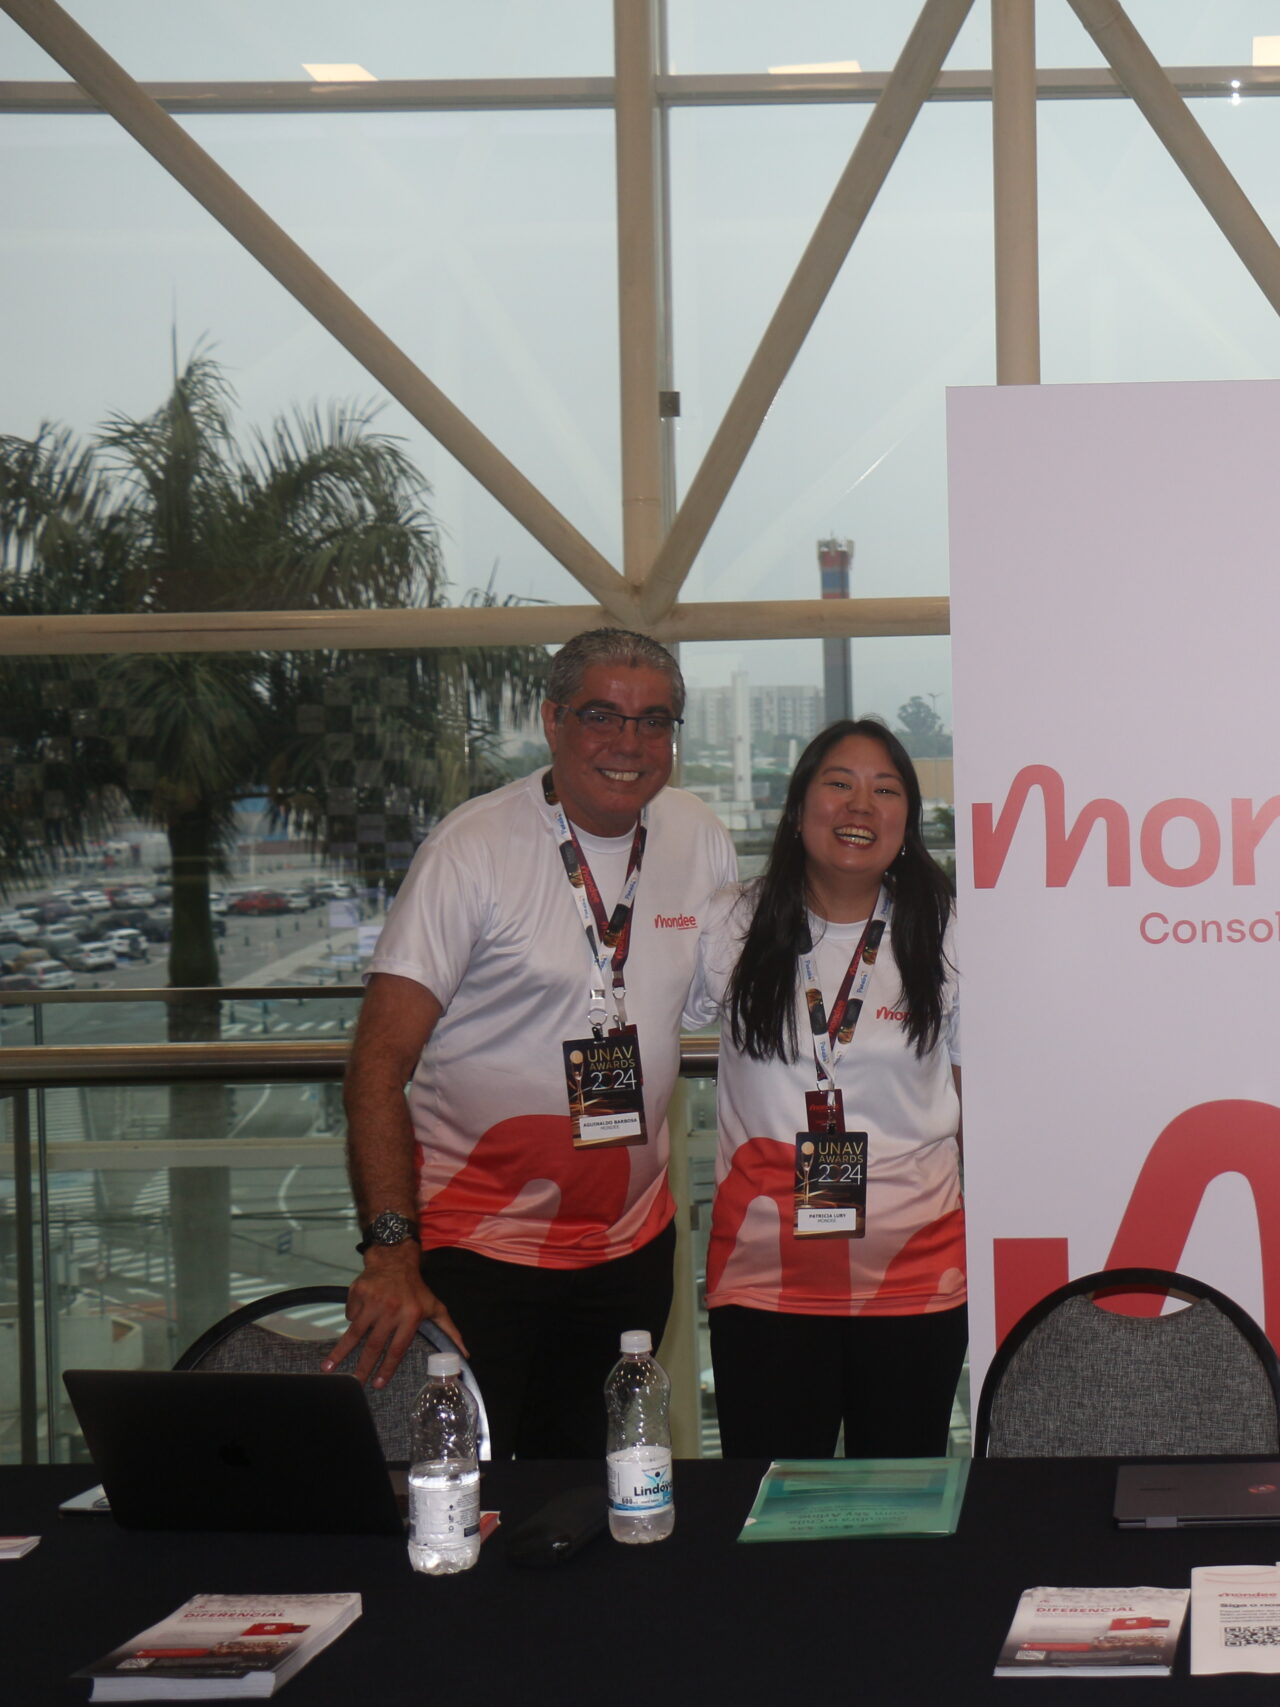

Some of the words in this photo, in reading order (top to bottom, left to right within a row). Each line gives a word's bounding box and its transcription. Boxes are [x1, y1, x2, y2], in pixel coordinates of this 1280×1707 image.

[654, 914, 697, 929] mondee
[587, 1047, 633, 1063] UNAV
[589, 1058, 636, 1070] AWARDS
[591, 1069, 637, 1091] 2024
[818, 1141, 864, 1154] UNAV
[818, 1154, 864, 1164] AWARDS
[818, 1164, 863, 1185] 2024
[1035, 1606, 1136, 1614] DIFERENCIAL
